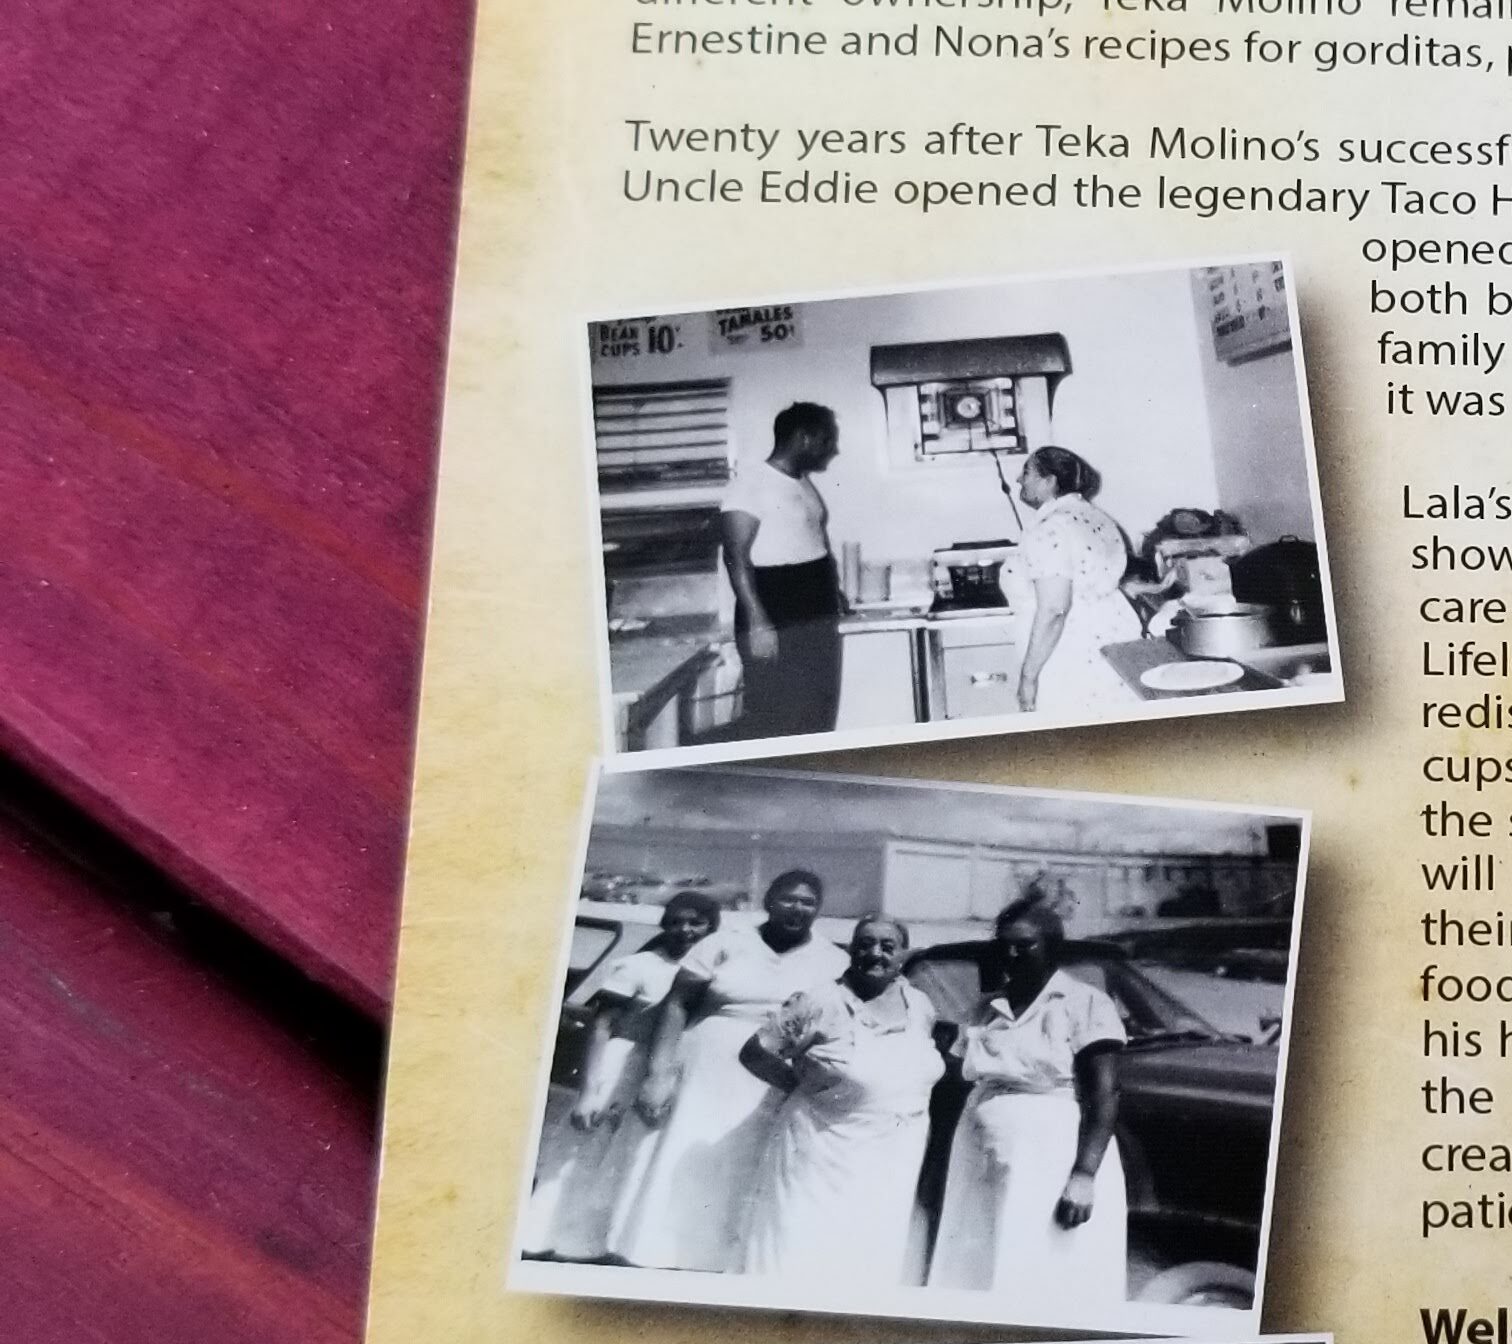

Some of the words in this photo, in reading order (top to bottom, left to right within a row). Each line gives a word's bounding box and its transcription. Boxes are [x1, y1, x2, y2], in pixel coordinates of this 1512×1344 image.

[625, 120, 780, 160] Twenty
[797, 129, 906, 161] years
[925, 122, 1023, 156] after
[1035, 124, 1129, 158] Teka
[1150, 127, 1319, 161] Molino's
[1371, 279, 1467, 315] both
[1388, 382, 1414, 414] it
[1426, 391, 1505, 416] was
[1404, 485, 1512, 520] Lala's
[1421, 1076, 1493, 1114] the
